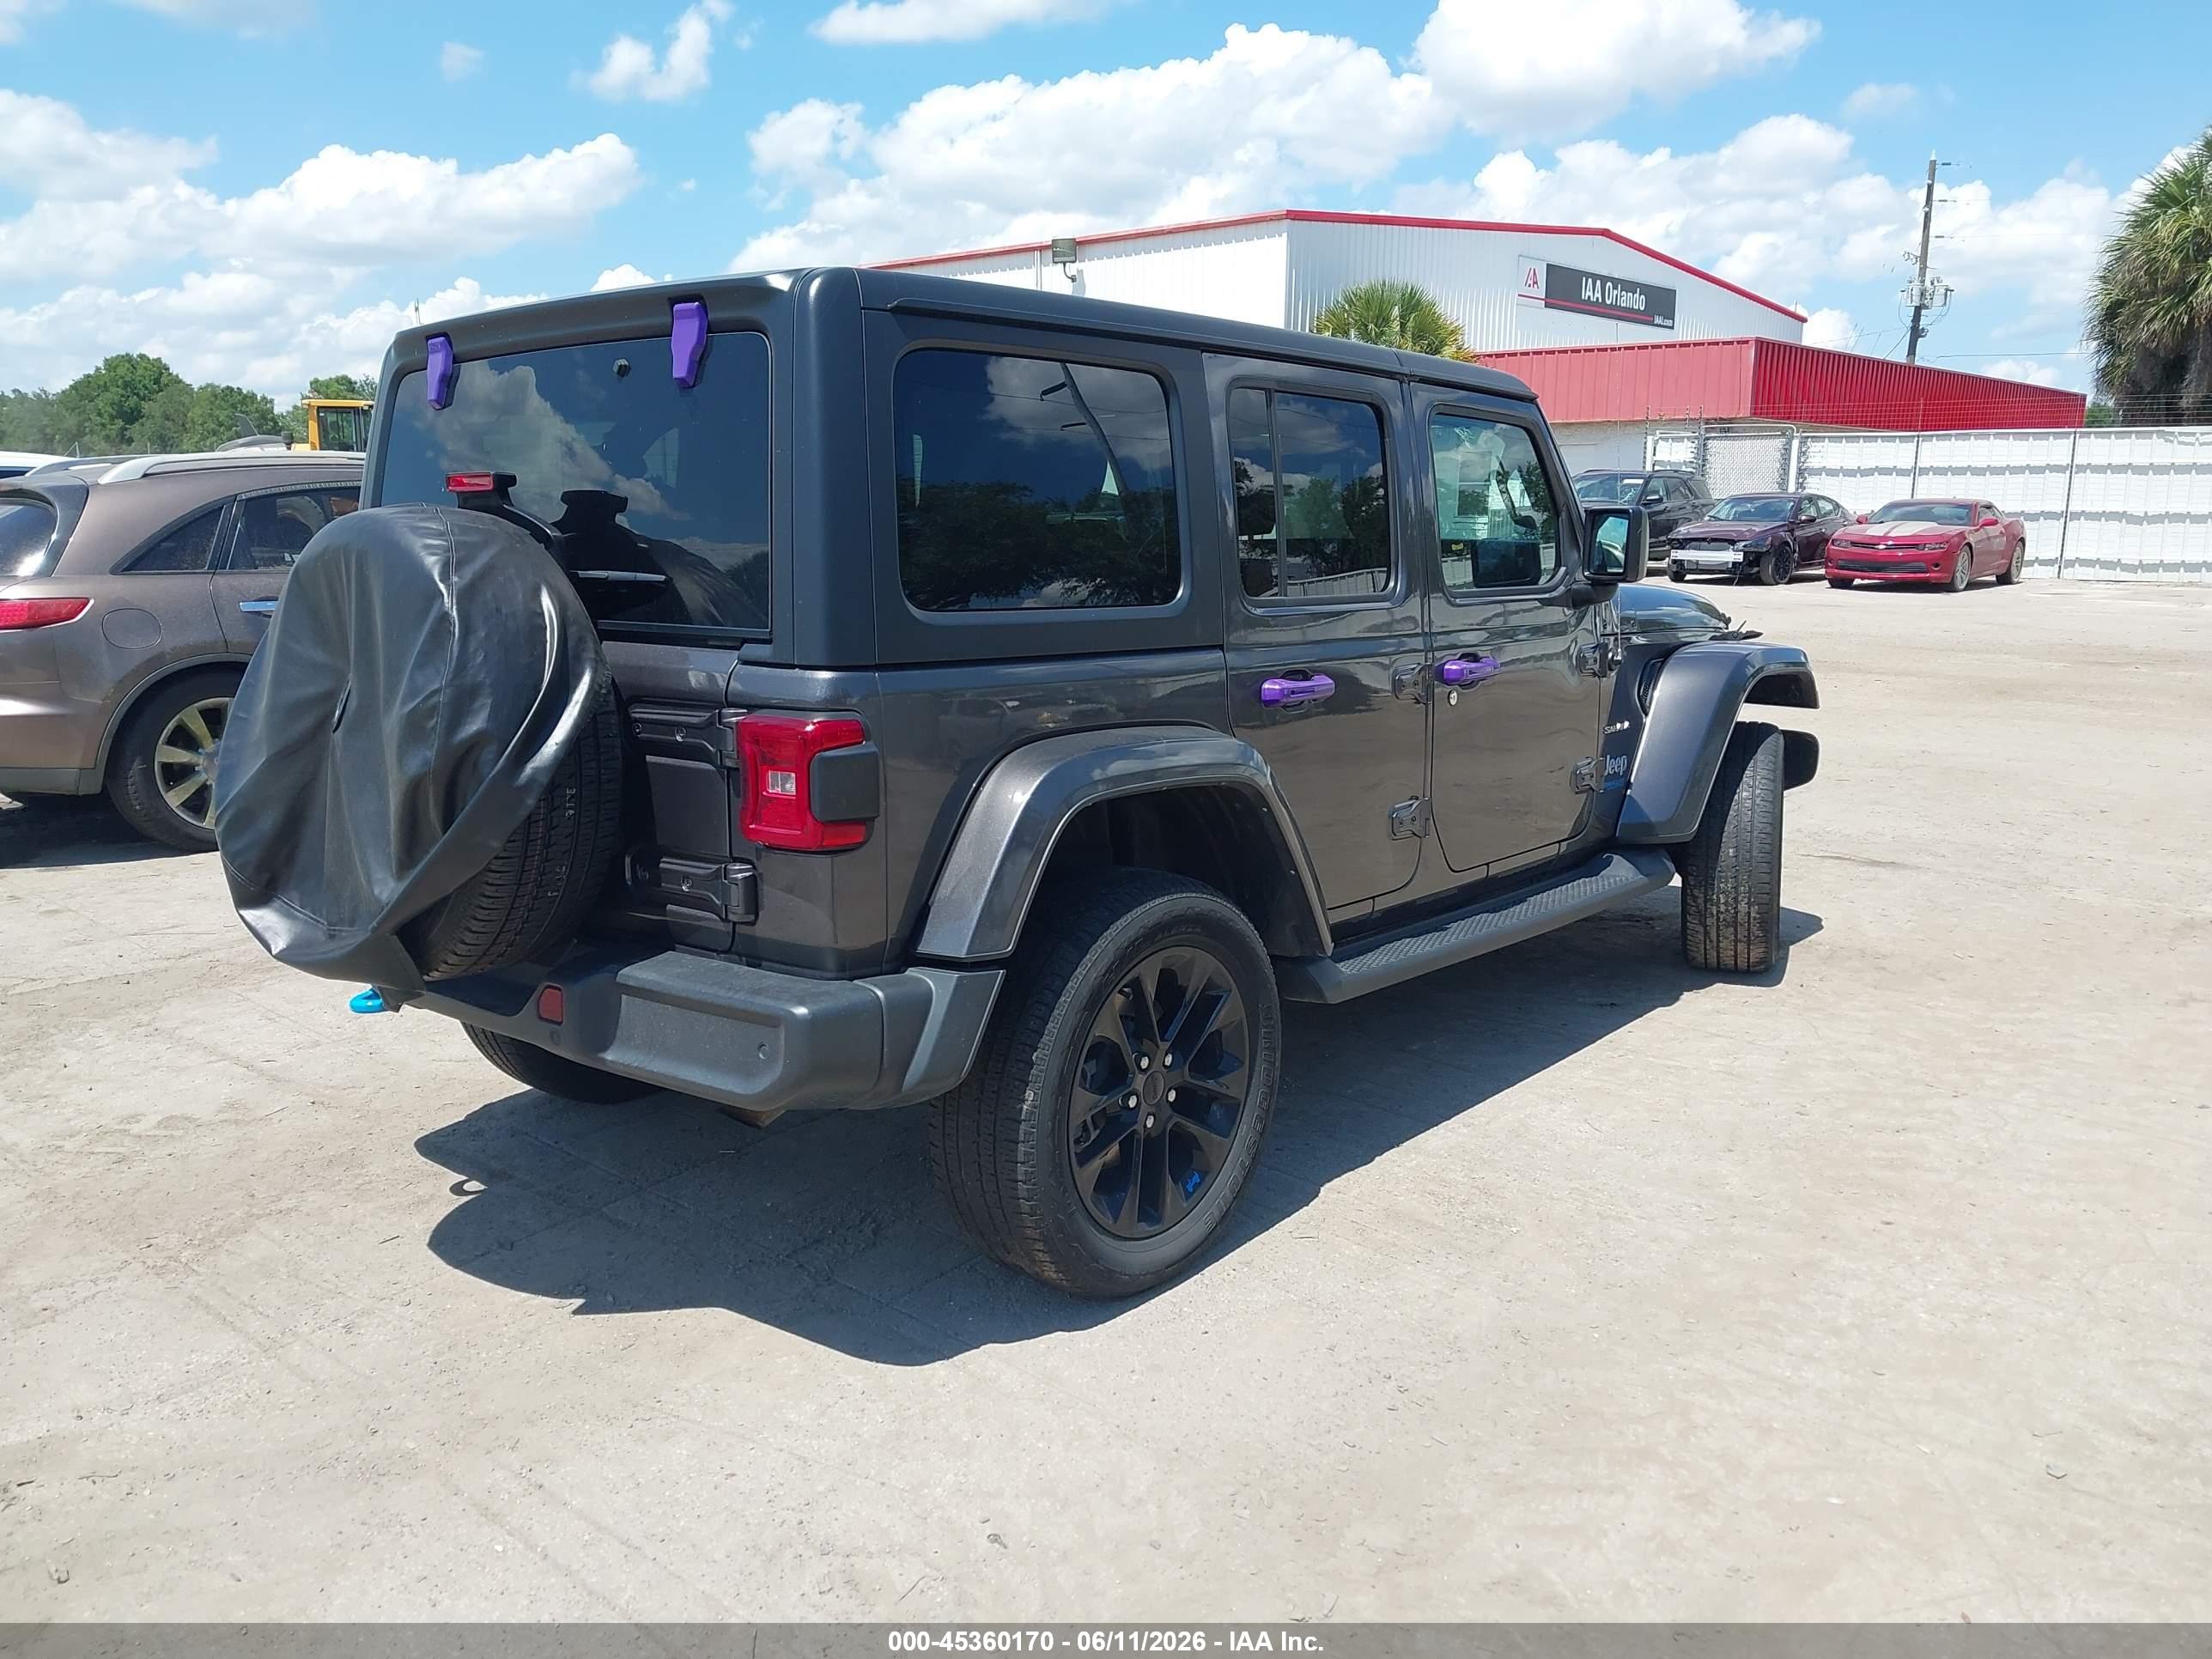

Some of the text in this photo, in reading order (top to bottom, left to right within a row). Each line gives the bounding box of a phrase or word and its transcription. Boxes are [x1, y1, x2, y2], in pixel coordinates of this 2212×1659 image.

[1581, 276, 1646, 311] IAA Orlando
[1604, 755, 1627, 776] Jeep
